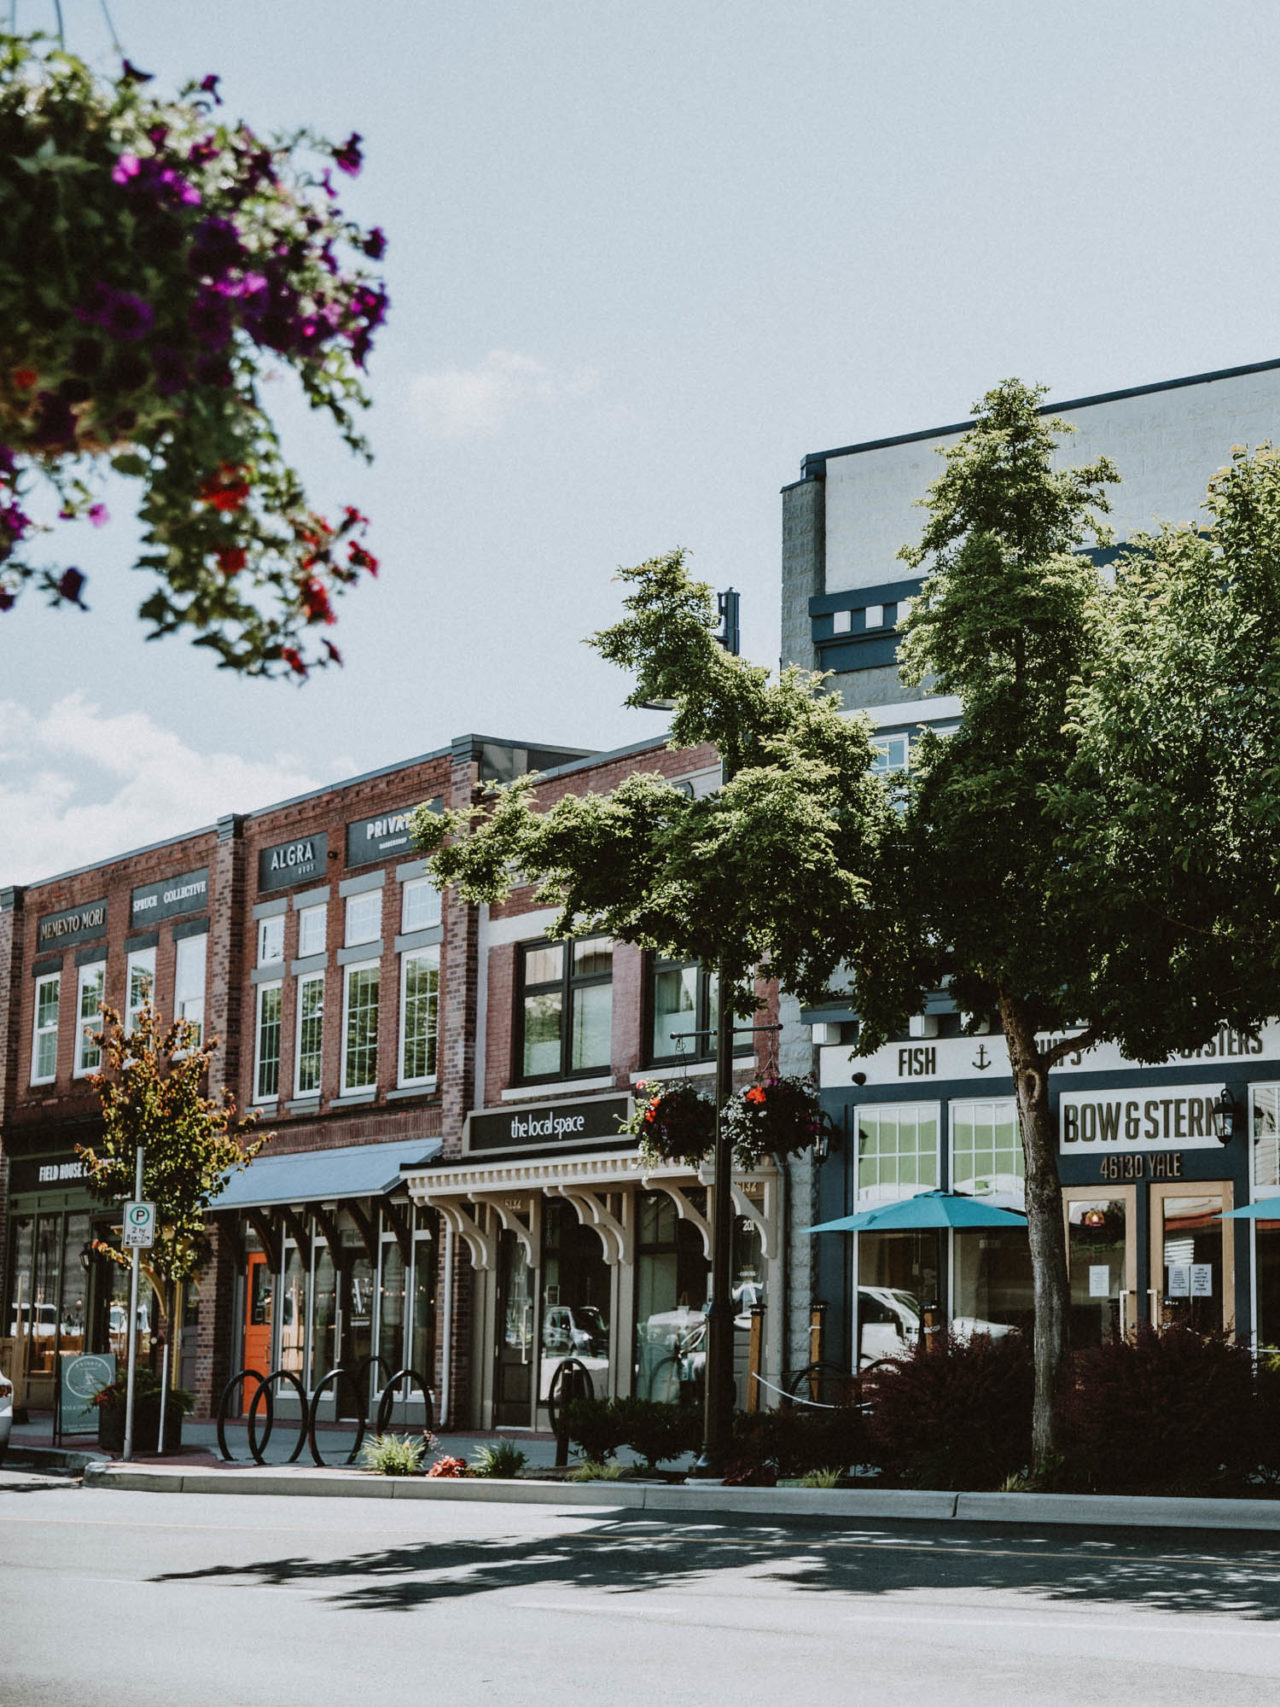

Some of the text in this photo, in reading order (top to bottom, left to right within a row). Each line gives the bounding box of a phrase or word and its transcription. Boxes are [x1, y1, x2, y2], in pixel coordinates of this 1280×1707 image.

[271, 841, 314, 871] ALGRA
[133, 881, 206, 913] SPRUCE COLLECTIVE
[40, 907, 105, 941] MEMENTO MORI
[899, 1046, 937, 1077] FISH
[38, 1164, 59, 1182] FIELD
[59, 1161, 82, 1180] HOUSE
[1099, 1153, 1181, 1179] 46130 YALE
[135, 1210, 145, 1222] P
